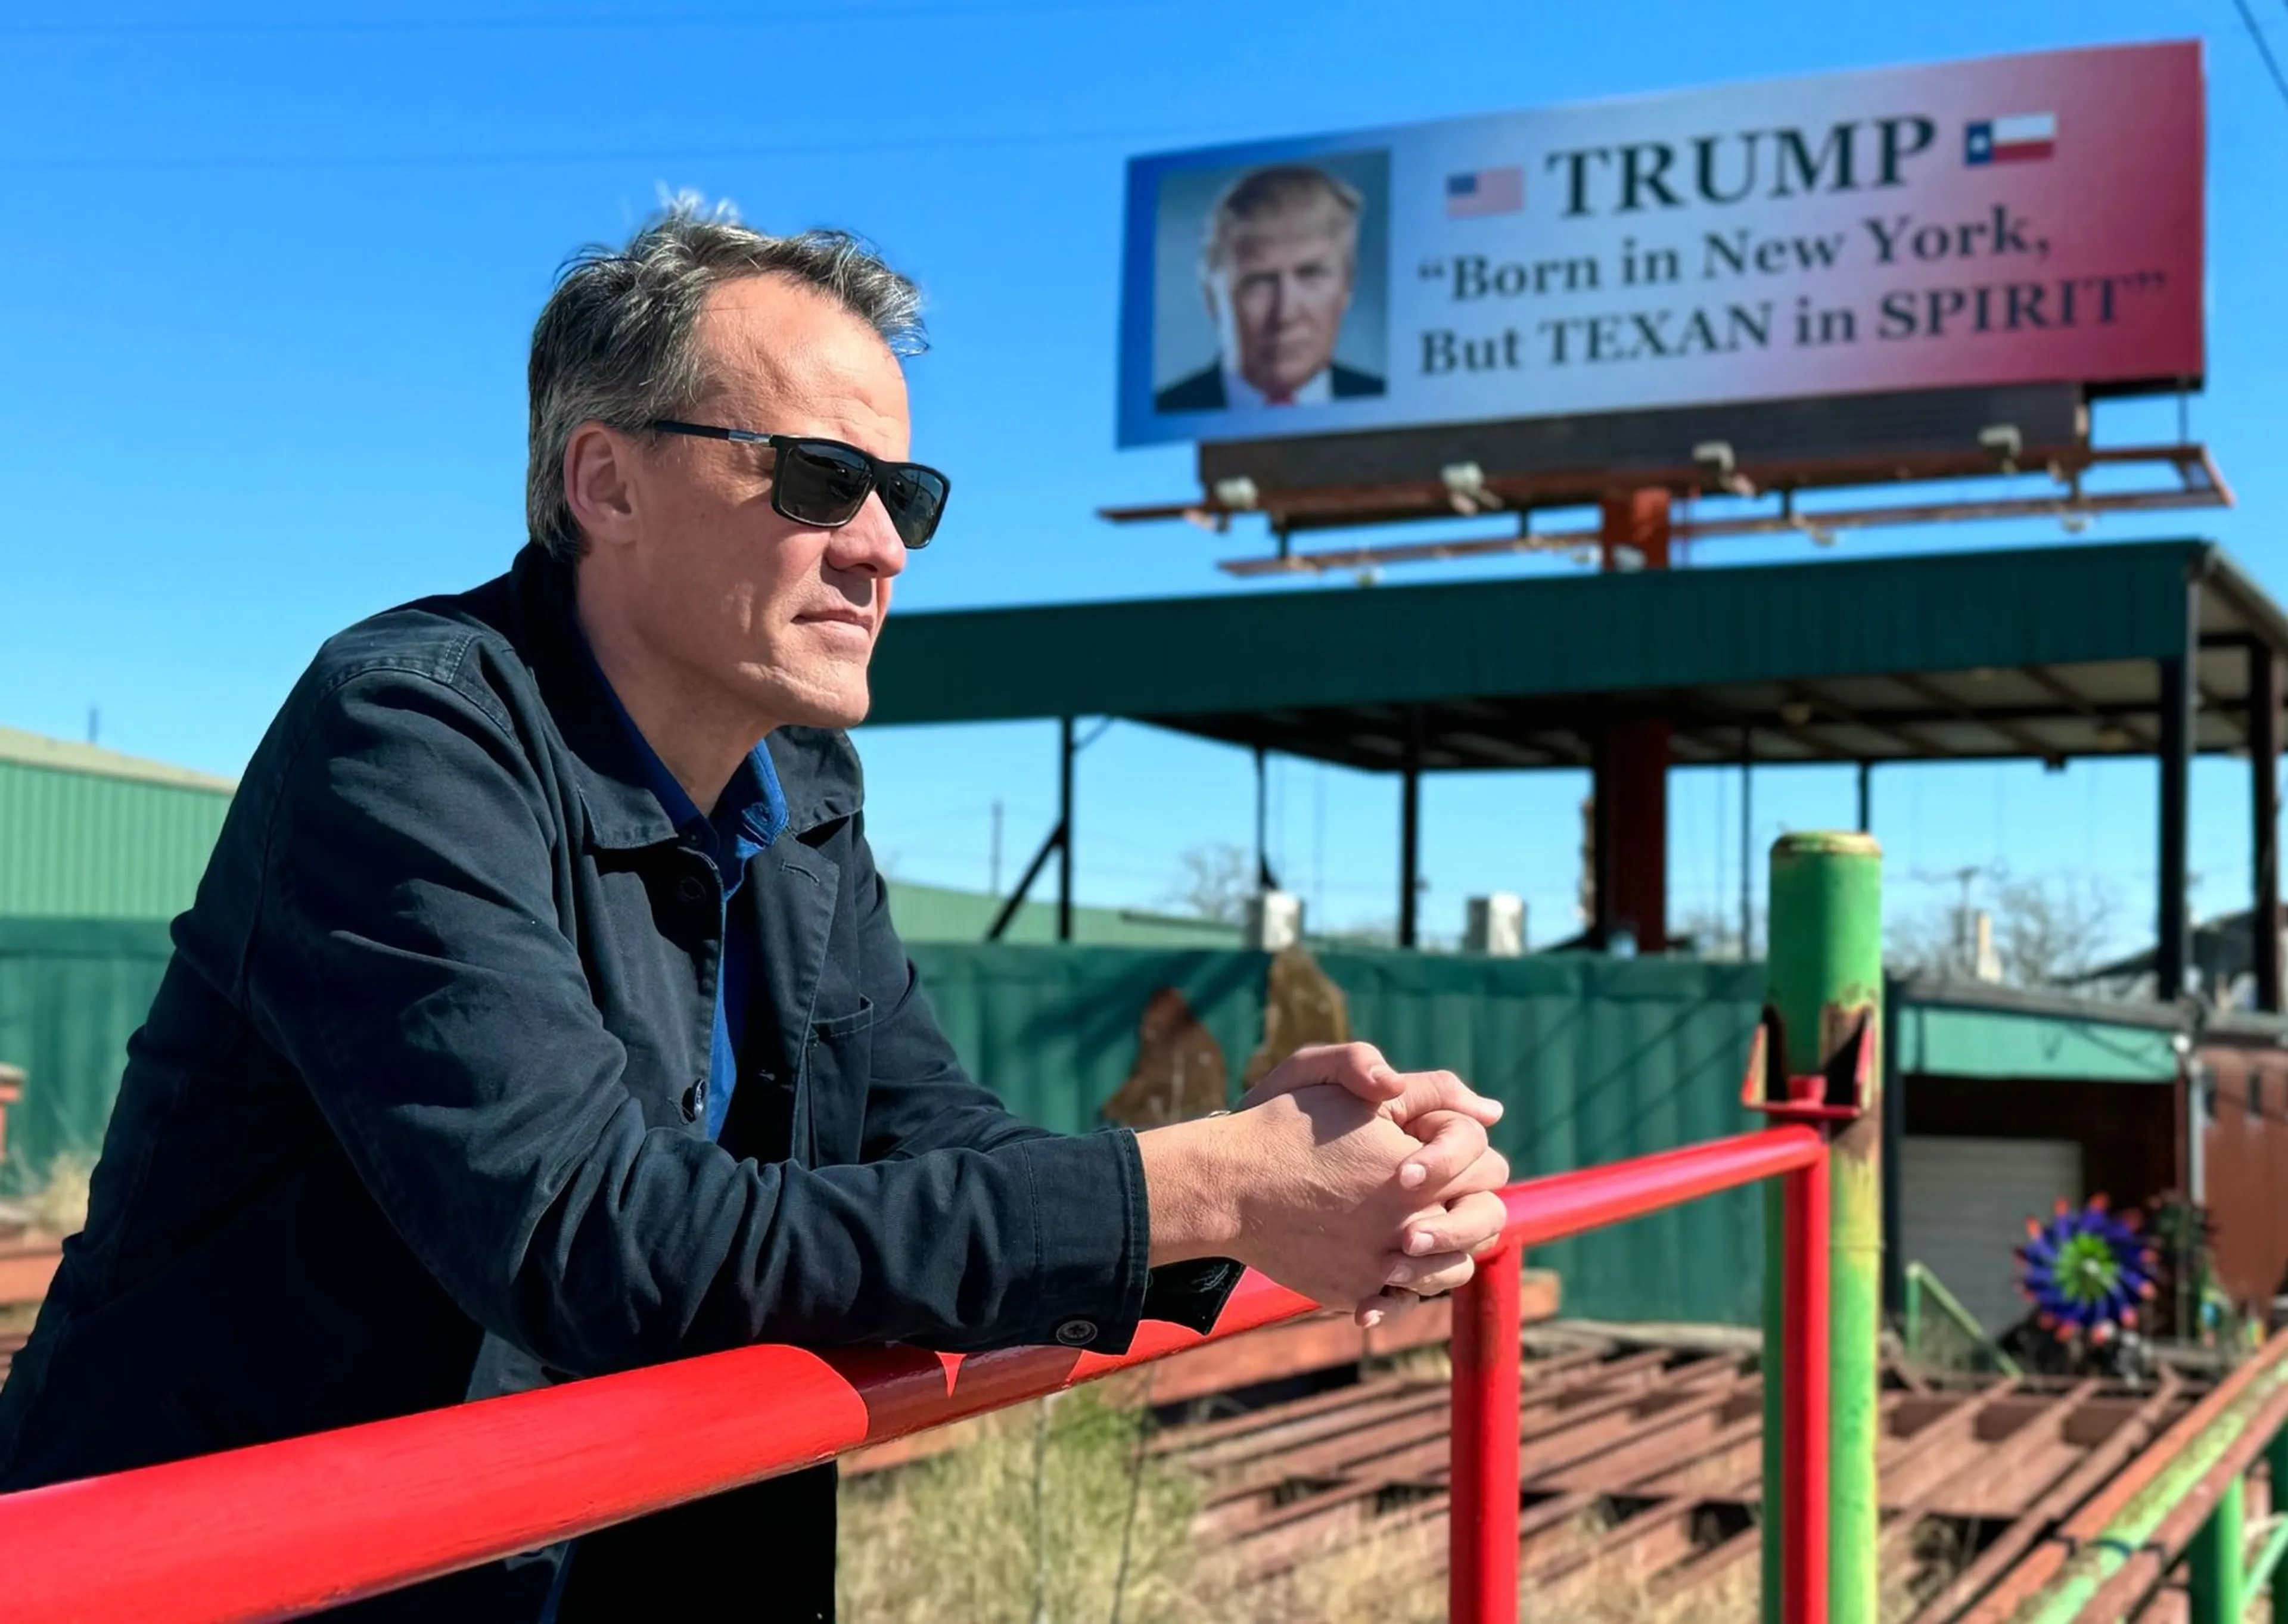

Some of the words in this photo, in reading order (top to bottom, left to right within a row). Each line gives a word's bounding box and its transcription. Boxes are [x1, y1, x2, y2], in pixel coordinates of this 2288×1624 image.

[1545, 114, 1935, 219] TRUMP
[1417, 253, 1600, 301] “Born
[1621, 237, 1680, 287] in
[1702, 229, 1846, 280] New
[1862, 204, 2051, 265] York,
[1418, 326, 1521, 376] But
[1537, 301, 1774, 367] TEXAN
[1795, 295, 1858, 347] in
[1879, 270, 2166, 341] SPIRIT”
